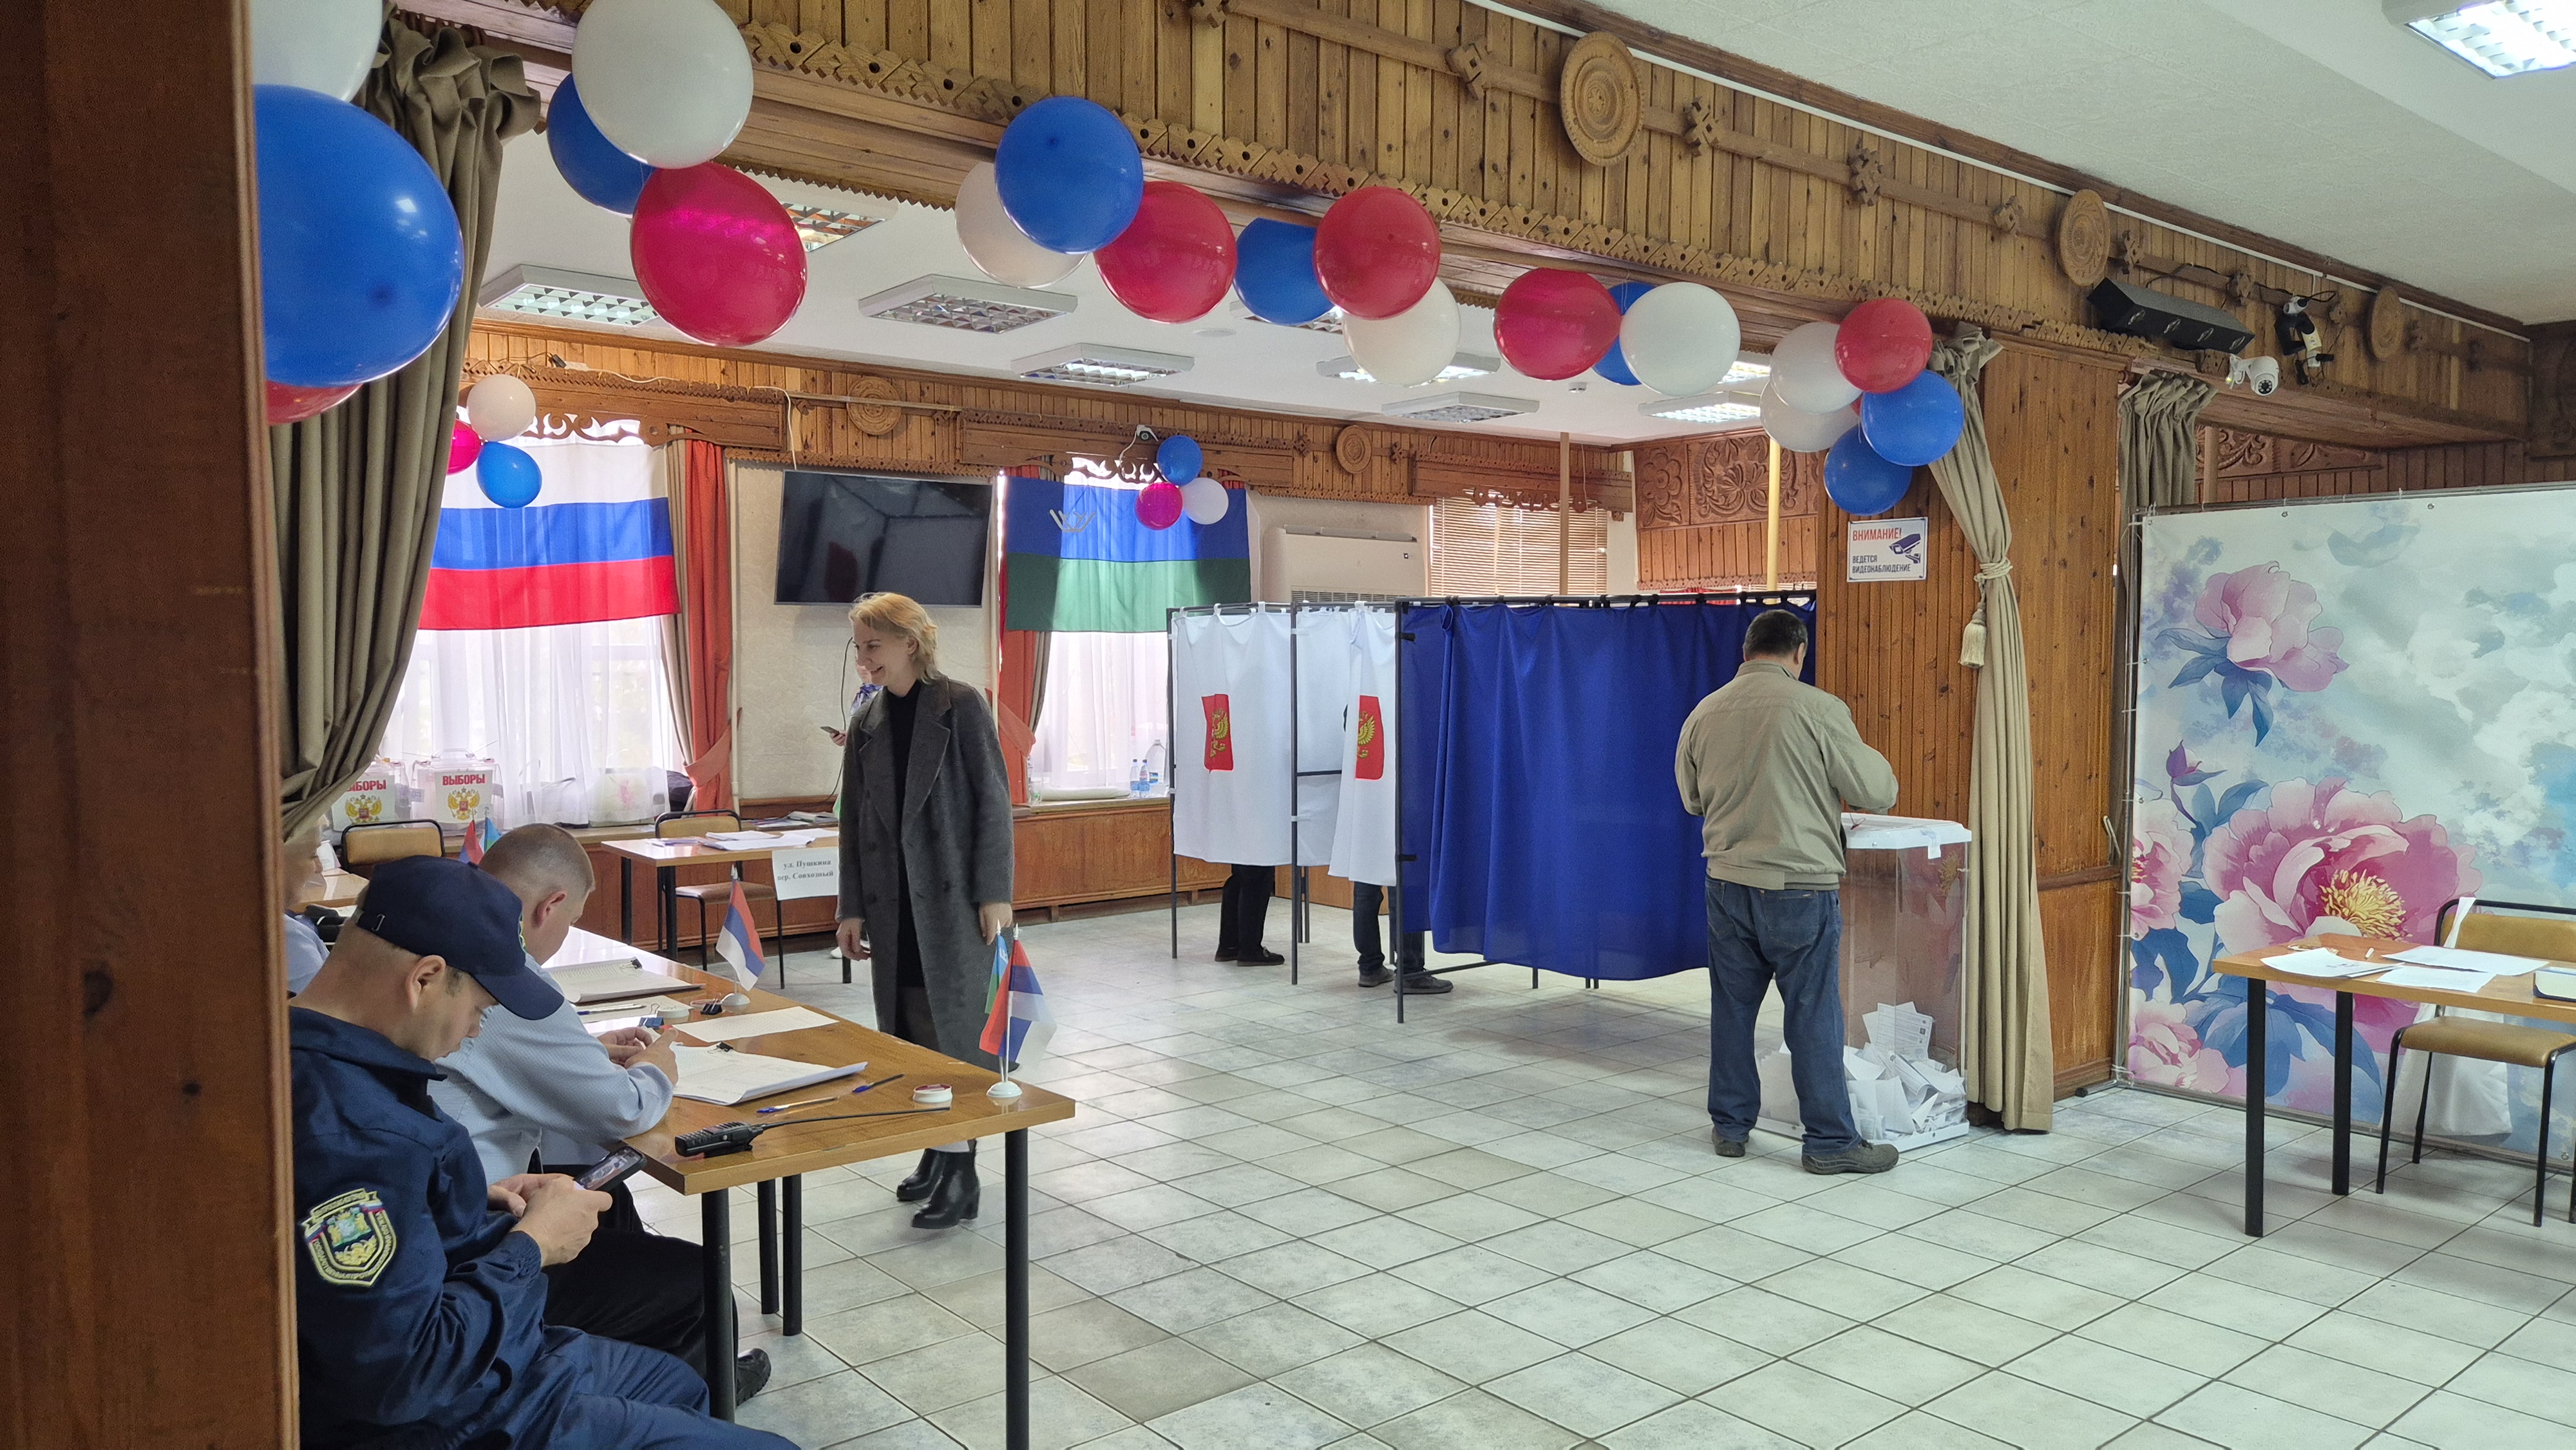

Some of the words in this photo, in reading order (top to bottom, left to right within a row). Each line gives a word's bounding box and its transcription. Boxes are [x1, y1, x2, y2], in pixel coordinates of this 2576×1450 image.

[1853, 527, 1902, 541] ВНИМАНИЕ!
[1852, 555, 1877, 563] ВЕДЕТСЯ
[1852, 564, 1911, 574] ВИДЕОНАБЛЮДЕНИЕ
[347, 779, 386, 791] БОРЫ
[442, 774, 485, 786] ВЫБОРЫ
[796, 860, 831, 869] Пушкина
[792, 871, 833, 880] Совхозный
